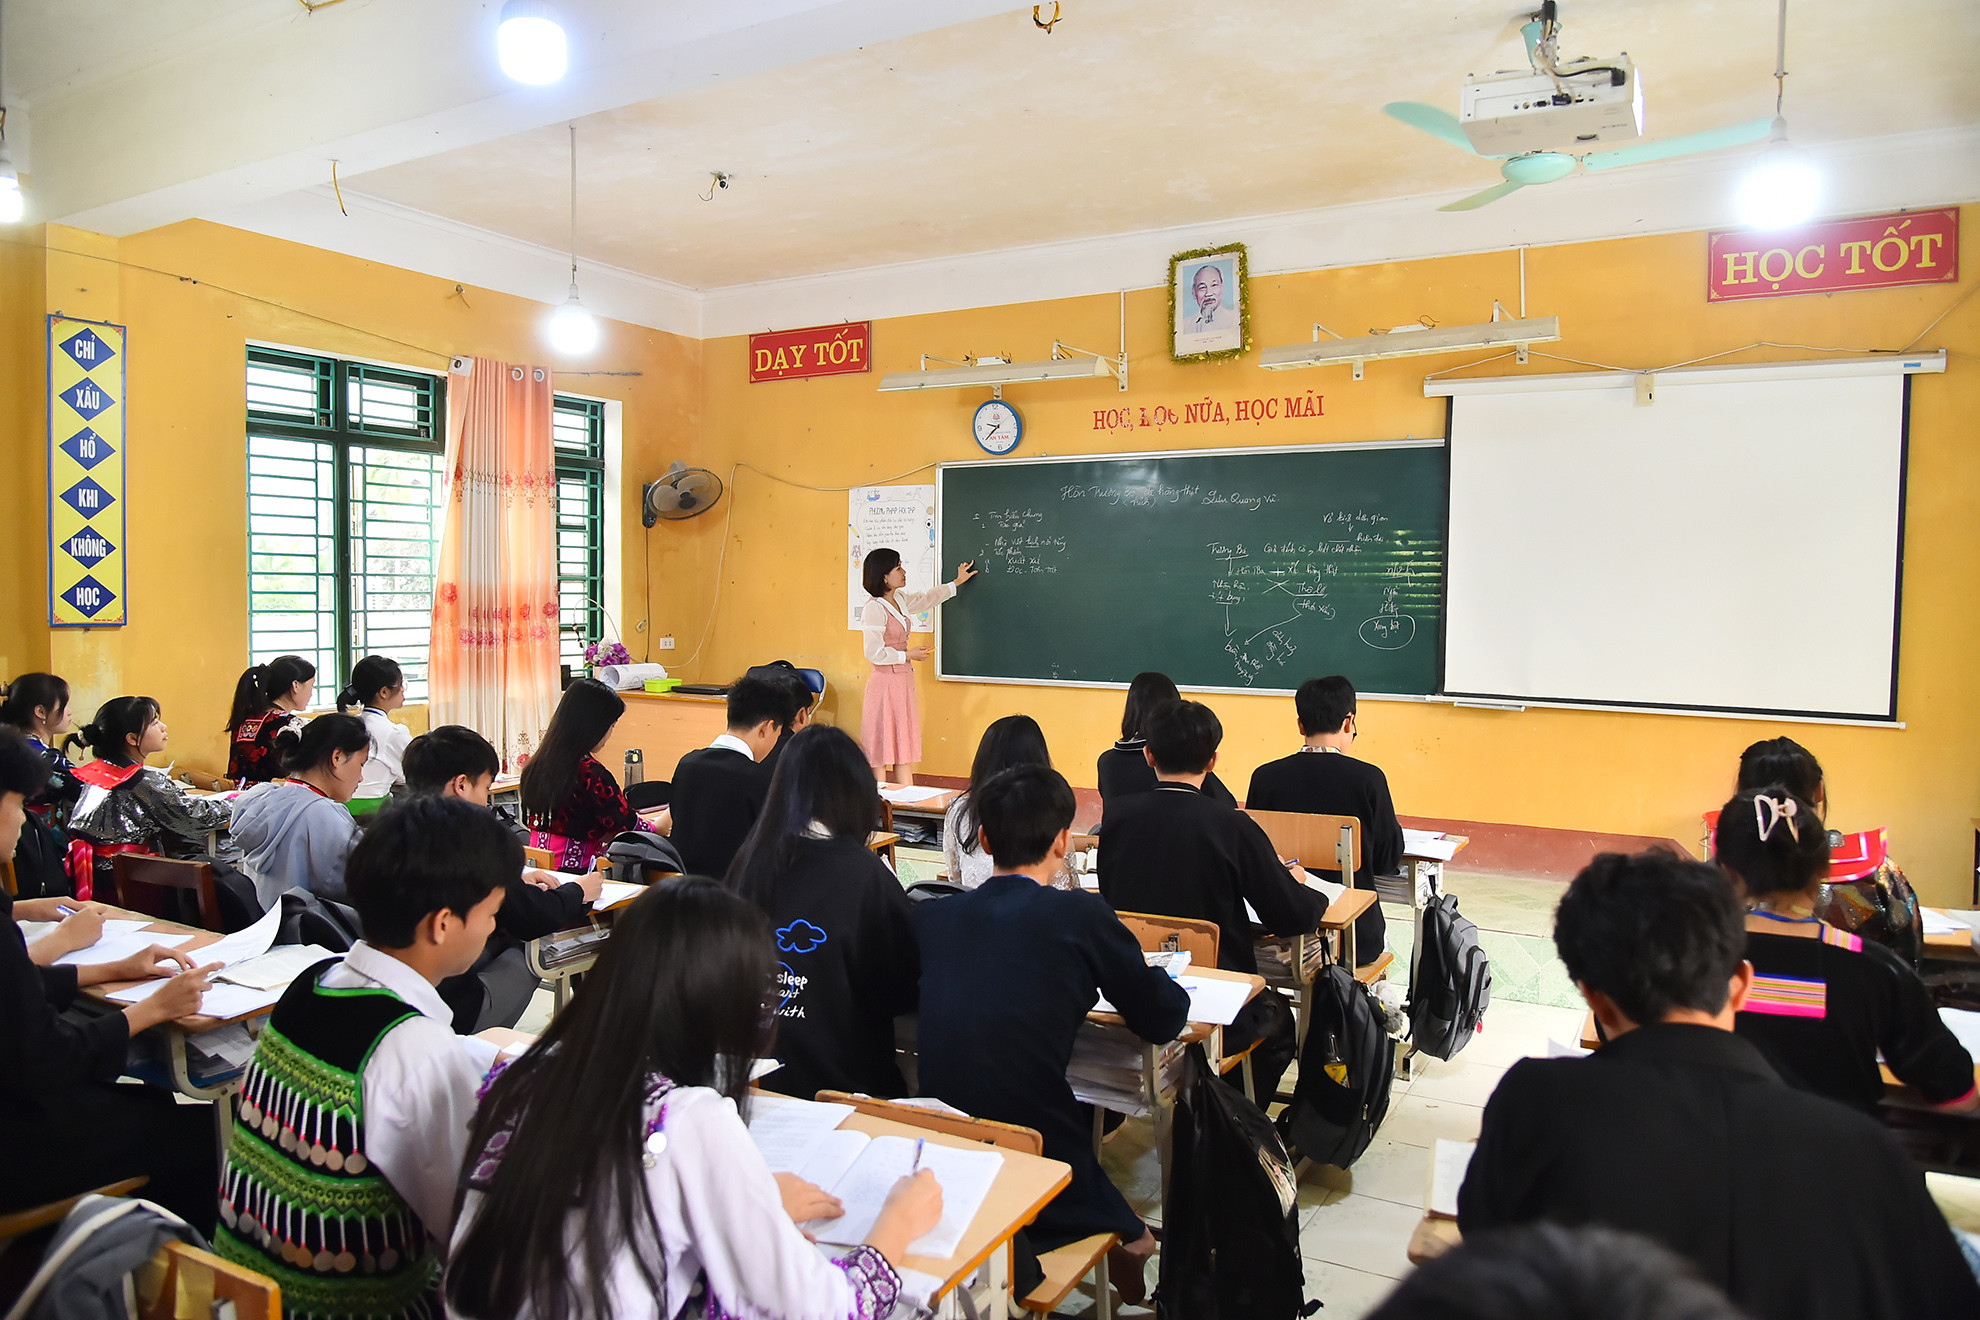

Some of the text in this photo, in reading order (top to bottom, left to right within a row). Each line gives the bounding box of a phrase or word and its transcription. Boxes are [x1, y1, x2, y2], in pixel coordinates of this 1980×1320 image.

[1722, 219, 1942, 290] HỌC TỐT
[74, 334, 95, 360] CHỈ
[755, 328, 863, 376] DẠY TỐT
[76, 384, 100, 410] XẤU
[1093, 407, 1134, 435] HỌC,
[1184, 396, 1230, 426] NỮA,
[1235, 397, 1278, 426] HỌC
[1284, 389, 1325, 418] MÃI
[80, 433, 96, 458] HỔ
[78, 488, 98, 508] KHI
[71, 534, 106, 557] KHÔNG
[76, 587, 100, 610] HỌC
[777, 971, 808, 990] sleep
